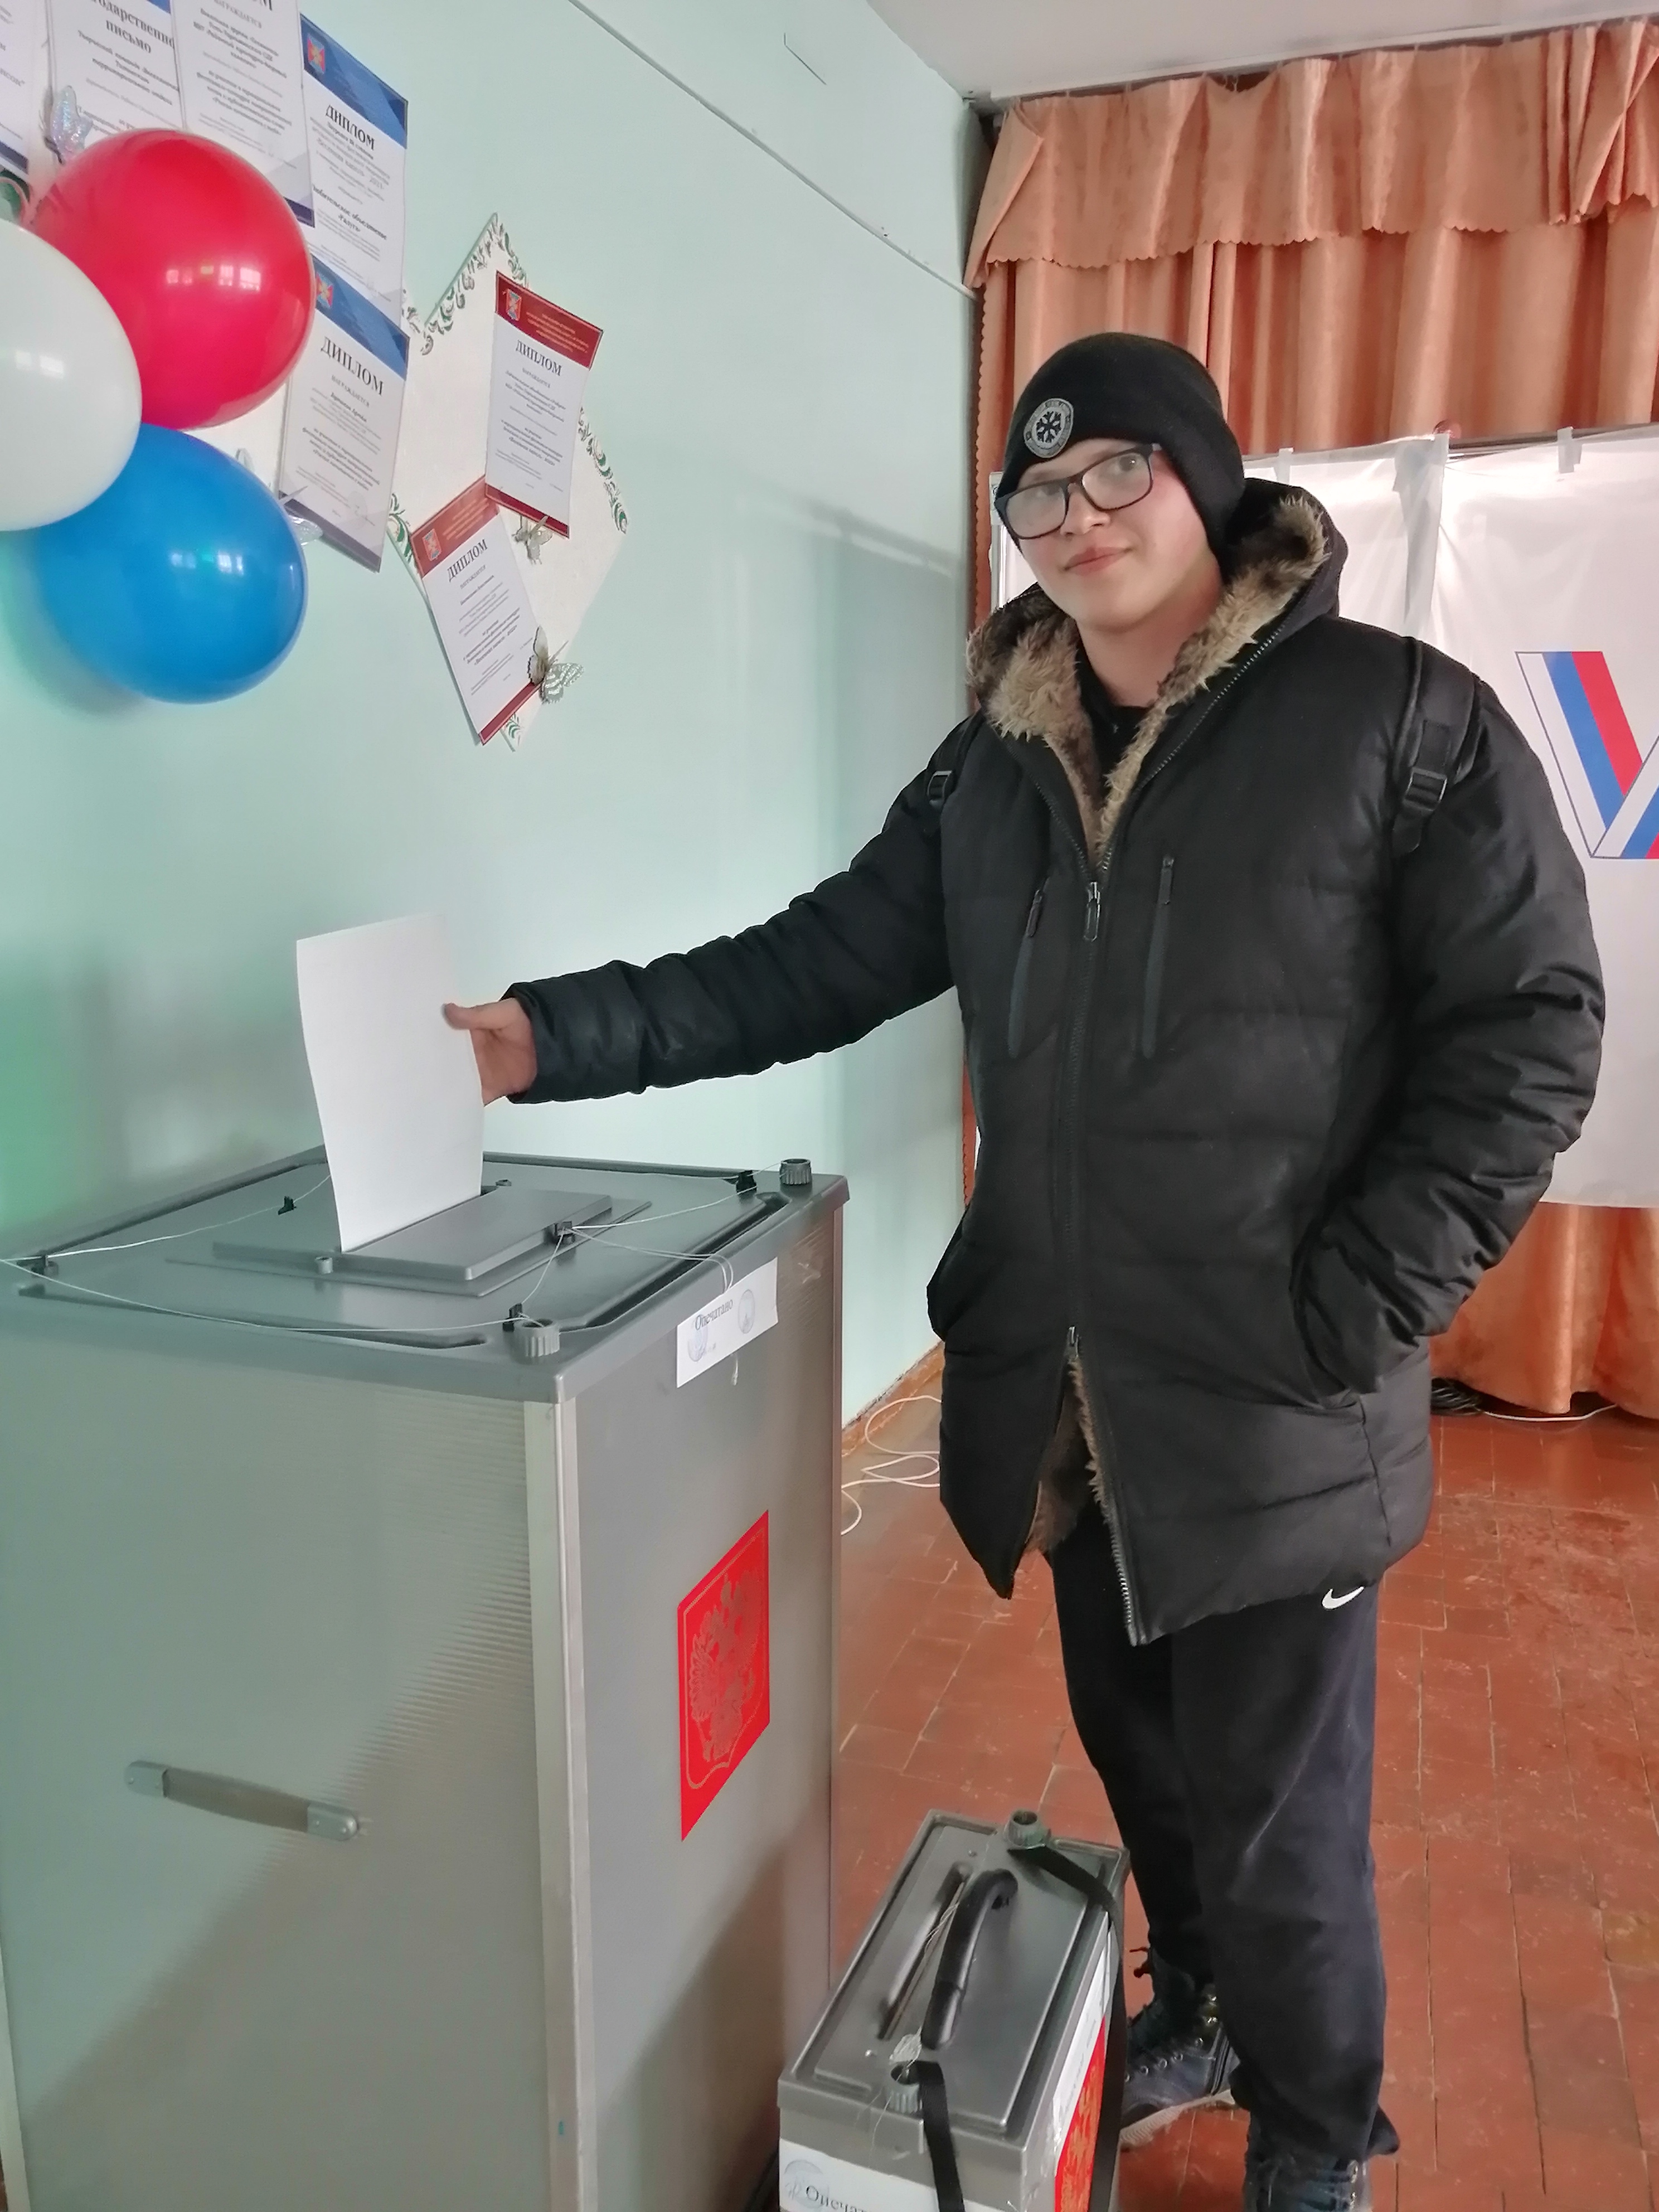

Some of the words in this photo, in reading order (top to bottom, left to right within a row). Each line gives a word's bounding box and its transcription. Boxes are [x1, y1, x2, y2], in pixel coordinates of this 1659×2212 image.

[106, 20, 151, 54] письмо
[325, 104, 375, 151] ДИПЛОМ
[321, 336, 384, 396] ДИПЛОМ
[515, 339, 563, 376] ДИПЛОМ
[447, 539, 488, 583] ДИПЛОМ
[695, 1299, 733, 1331] Опечатано
